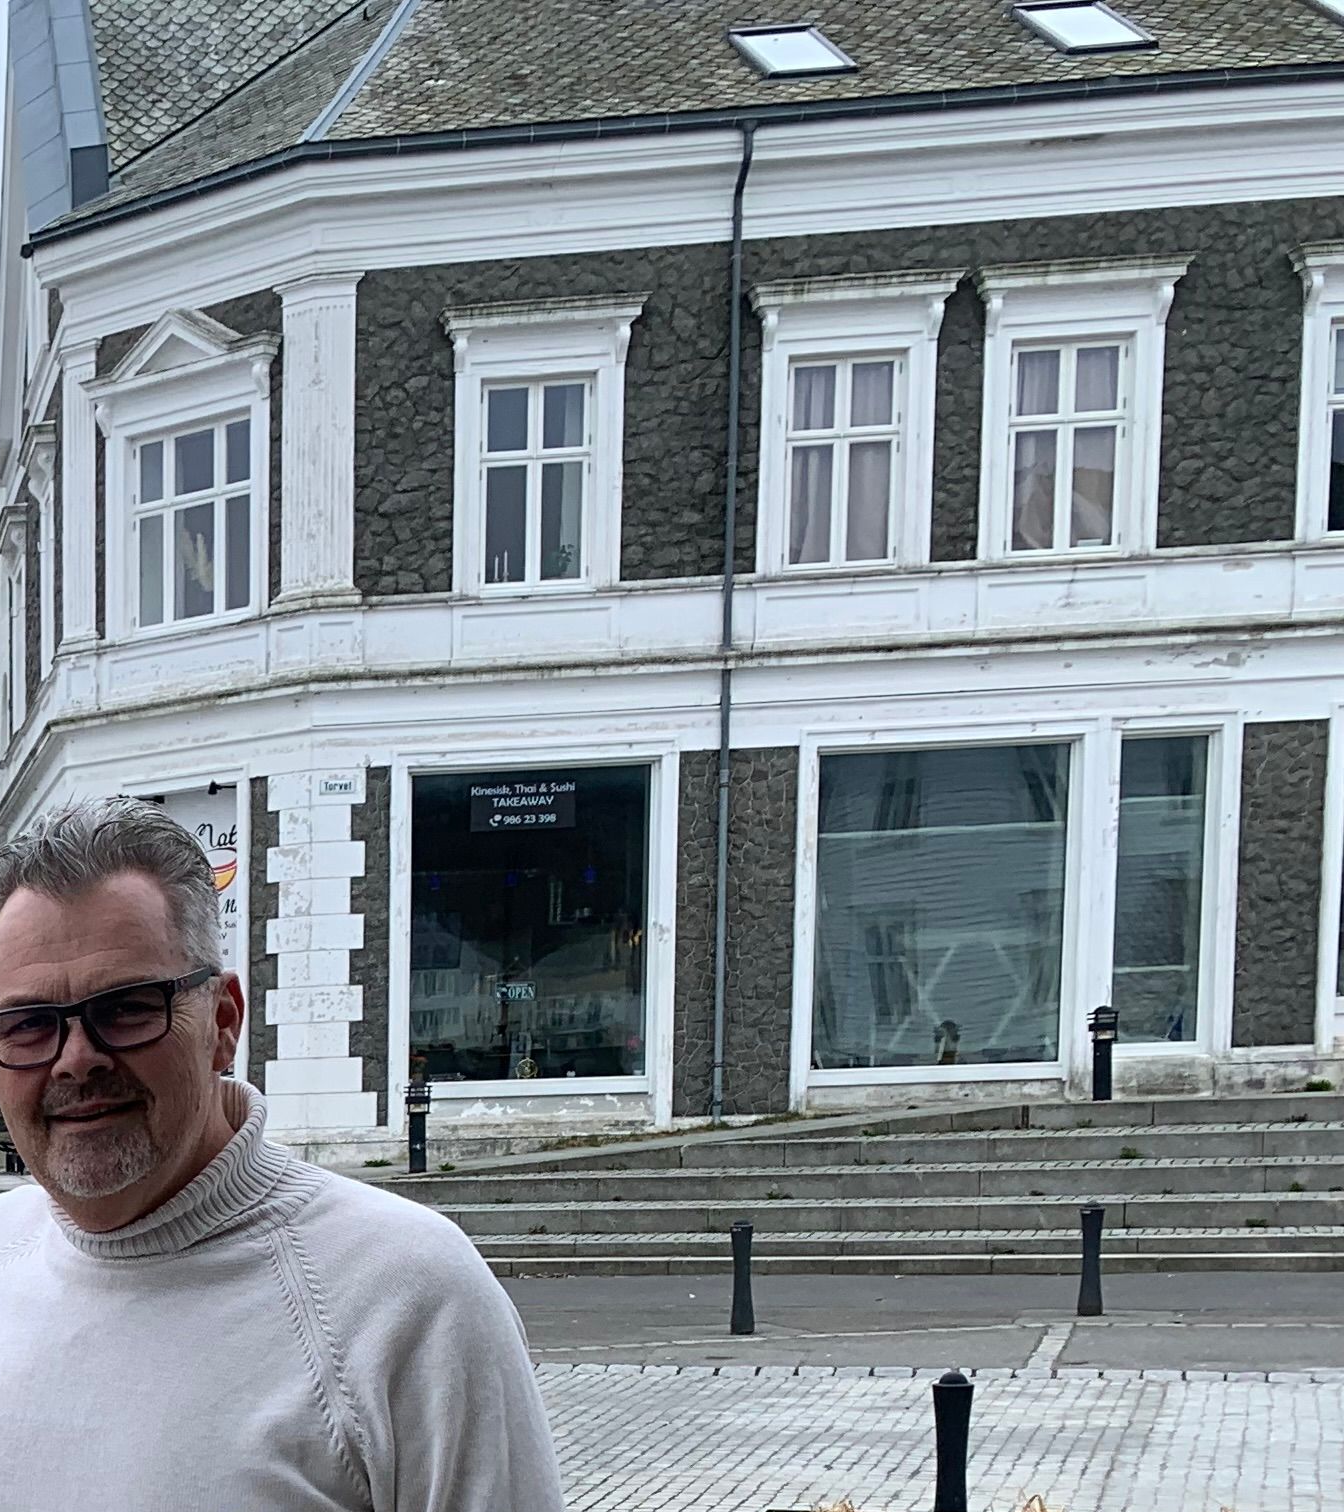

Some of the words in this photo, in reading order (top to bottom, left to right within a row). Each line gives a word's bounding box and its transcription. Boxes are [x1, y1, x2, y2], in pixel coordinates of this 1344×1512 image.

[324, 781, 352, 791] Torvet
[471, 785, 512, 796] Kinesisk,
[514, 784, 537, 794] Thai
[539, 783, 547, 793] &
[550, 782, 576, 792] Sushi
[492, 795, 554, 807] TAKEAWAY
[523, 814, 536, 824] 23
[538, 813, 557, 823] 398
[508, 986, 535, 999] OPEN
